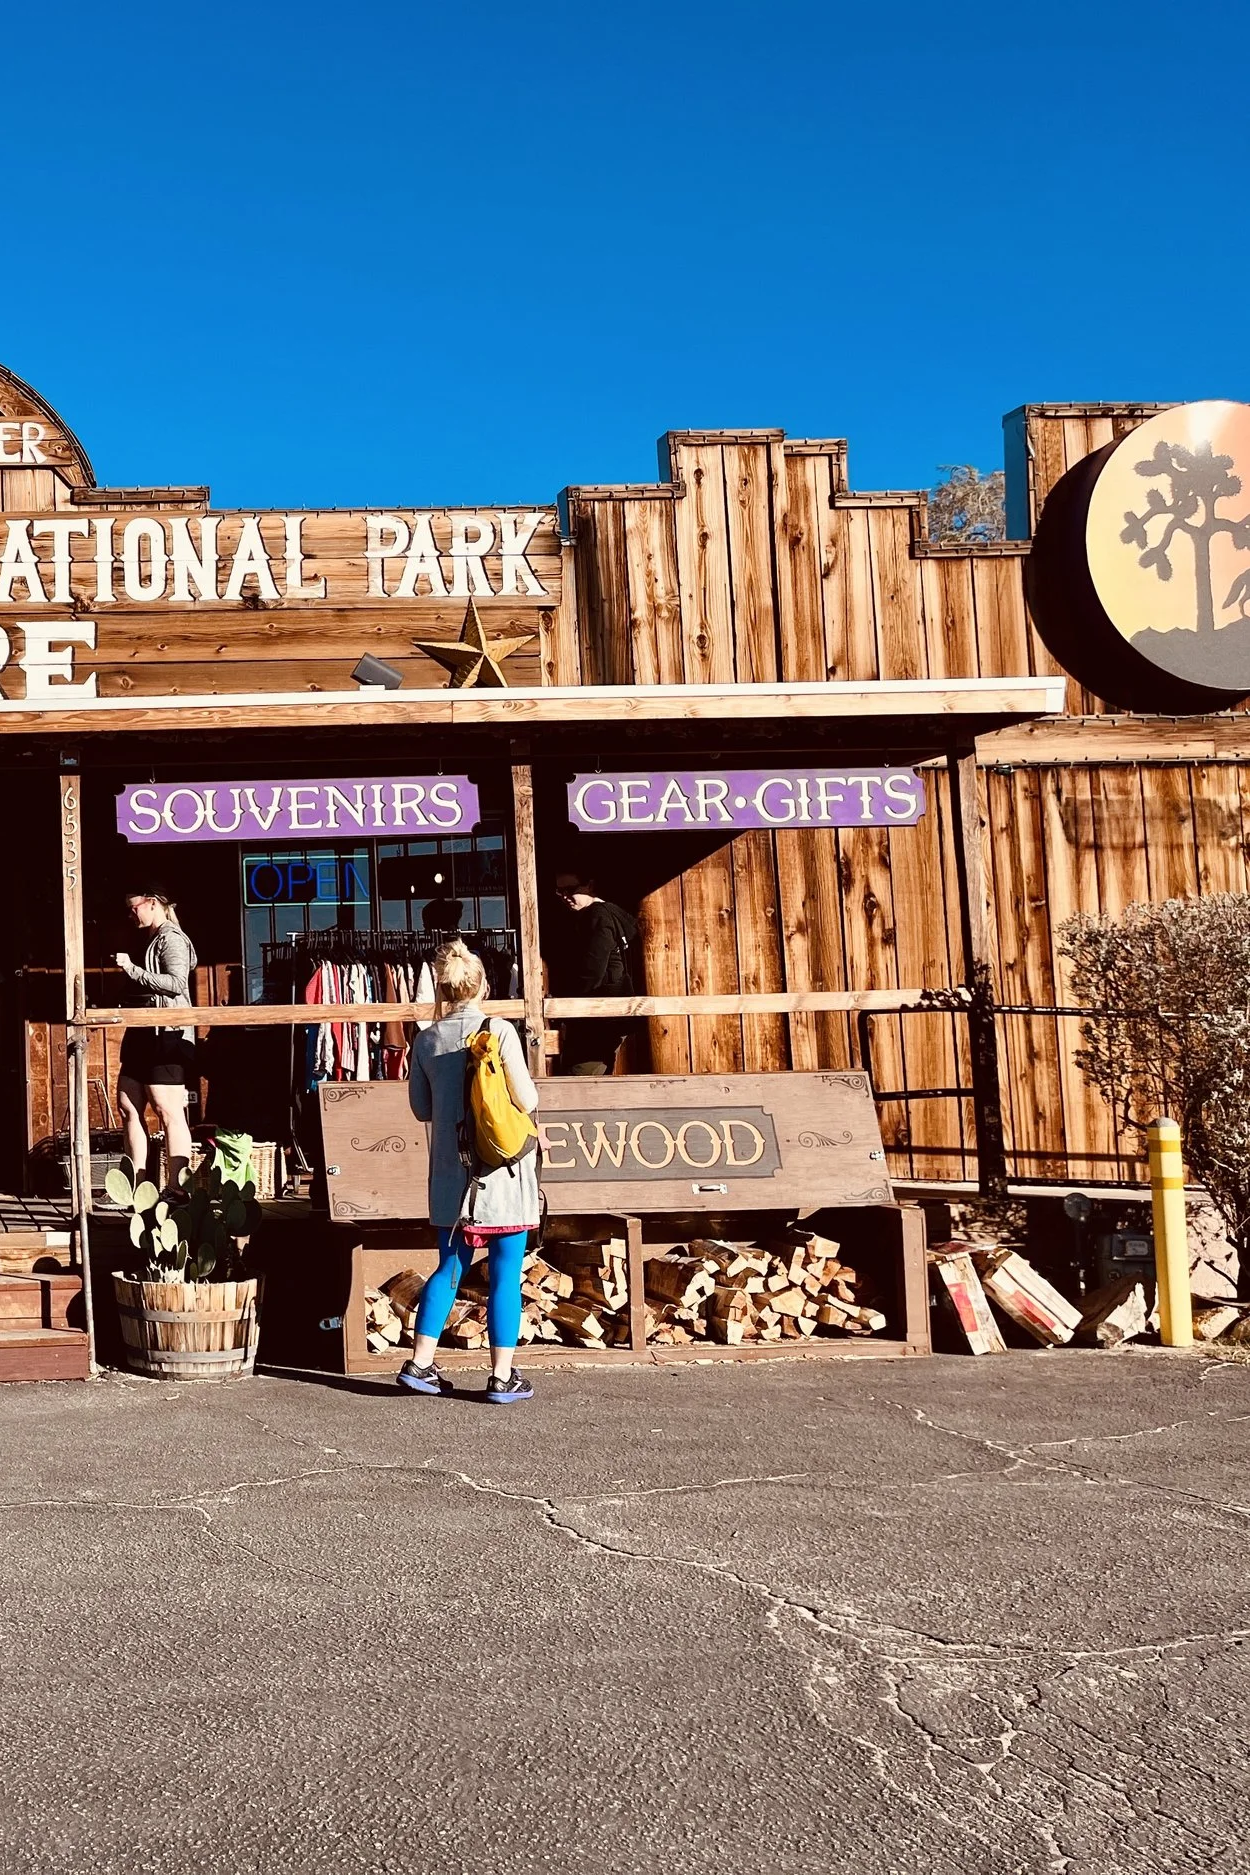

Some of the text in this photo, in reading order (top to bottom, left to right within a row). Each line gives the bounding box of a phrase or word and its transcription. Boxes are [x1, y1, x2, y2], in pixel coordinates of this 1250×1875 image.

[363, 512, 550, 598] PARK
[128, 781, 464, 836] SOUVENIRS
[574, 774, 918, 824] GEAR GIFTS
[61, 786, 79, 891] 6535
[250, 861, 370, 901] OPEN
[540, 1119, 766, 1170] EWOOD
